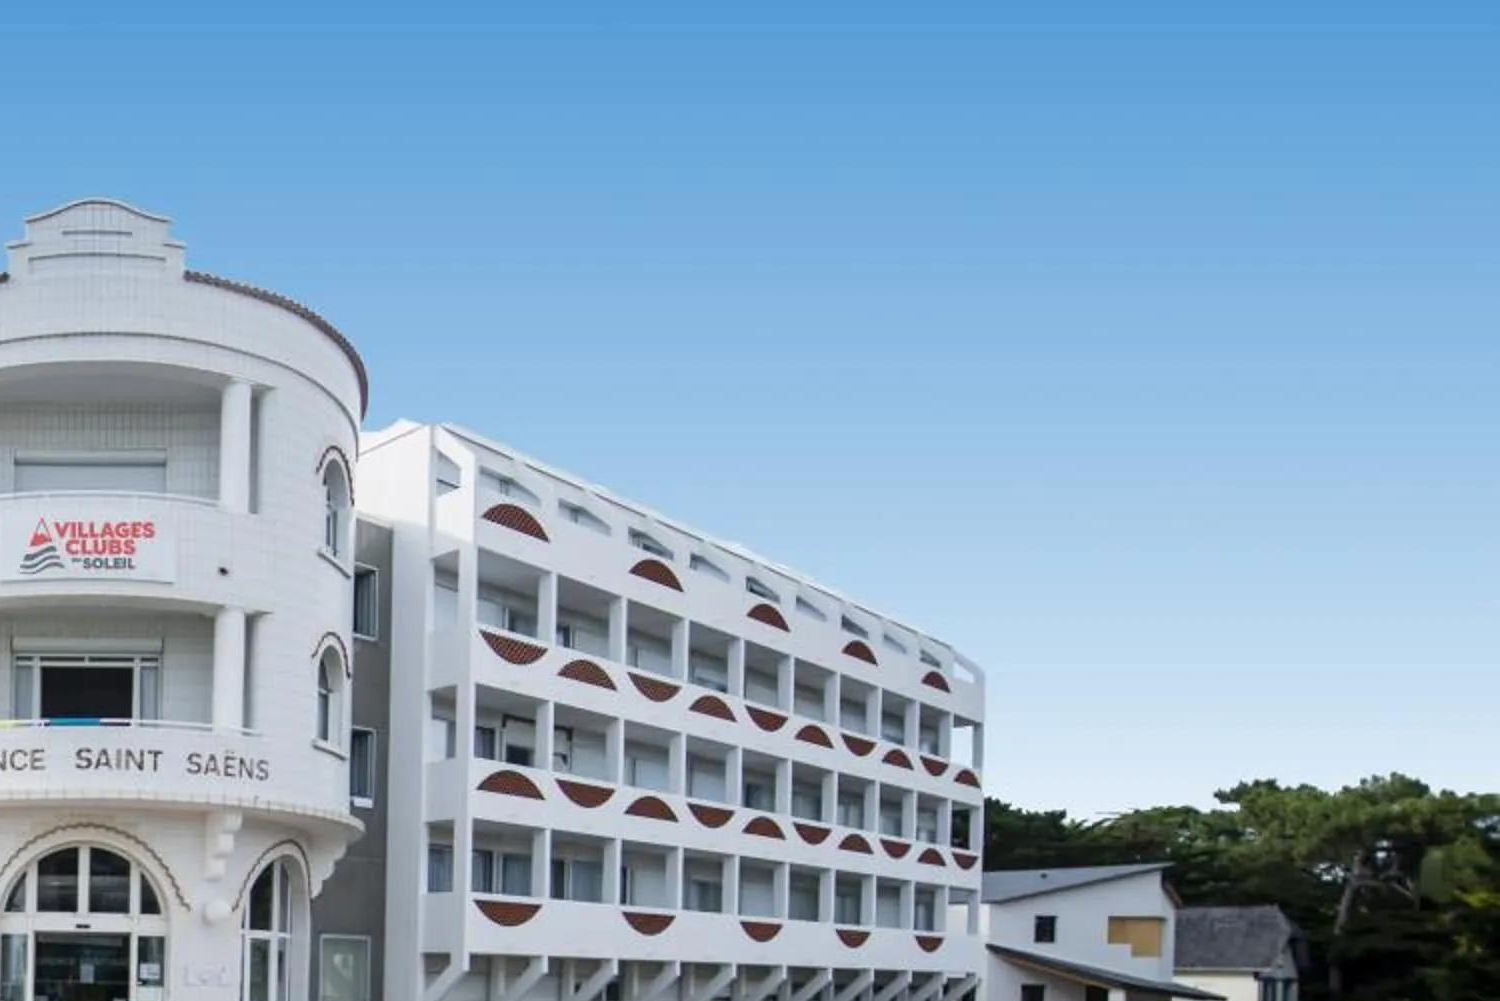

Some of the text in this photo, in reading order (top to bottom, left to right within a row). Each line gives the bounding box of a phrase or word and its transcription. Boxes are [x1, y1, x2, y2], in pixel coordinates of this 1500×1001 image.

[54, 522, 155, 538] VILLAGES
[66, 539, 136, 555] CLUBS
[83, 557, 135, 569] SOLEIL
[74, 747, 164, 772] SAINT
[185, 750, 270, 782] SAËNS
